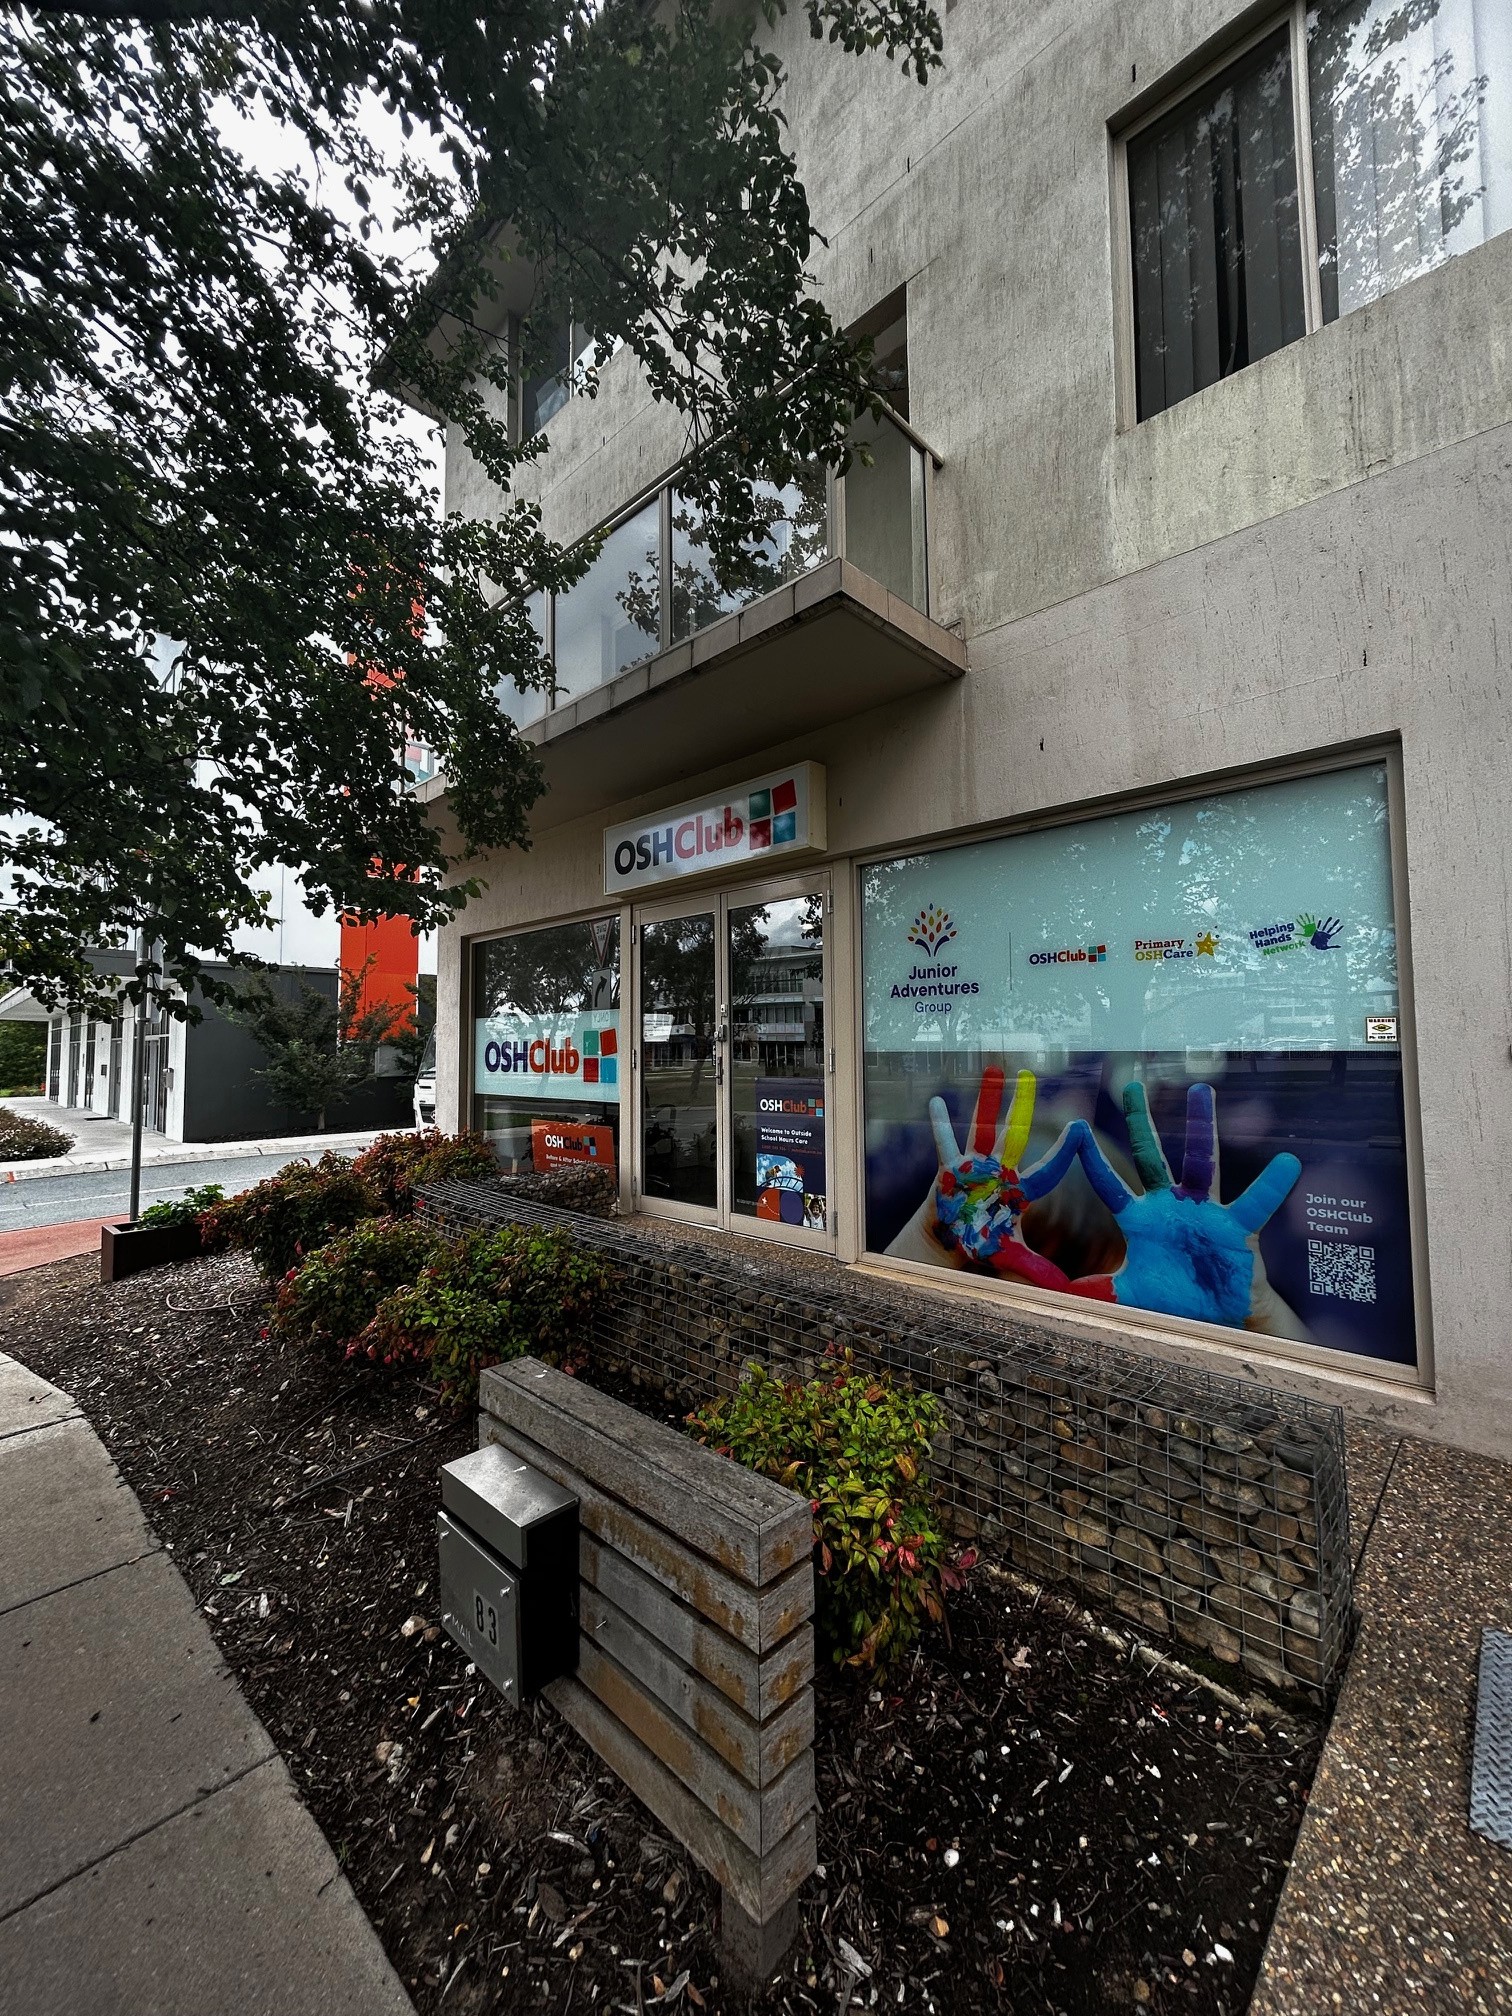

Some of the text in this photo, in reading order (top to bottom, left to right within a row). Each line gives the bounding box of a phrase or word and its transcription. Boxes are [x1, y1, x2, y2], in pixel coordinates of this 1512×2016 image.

[614, 806, 744, 875] OSHClub
[1249, 922, 1296, 940] Helping
[1135, 939, 1185, 950] Primary
[1255, 933, 1292, 949] Hands
[1262, 940, 1306, 956] Network
[1029, 949, 1087, 965] OSHClub
[1135, 949, 1193, 961] OSHCare
[909, 963, 958, 980] Junior
[890, 982, 980, 999] Adventures
[914, 1001, 952, 1014] Group
[485, 1037, 580, 1074] OSHClub
[759, 1098, 807, 1114] OSHClub
[760, 1127, 783, 1135] Welcome
[545, 1134, 583, 1152] OSHClub
[1306, 1193, 1367, 1209] Join our
[1306, 1207, 1373, 1224] OSHClub
[1307, 1221, 1349, 1235] Team
[475, 1594, 498, 1646] 83
